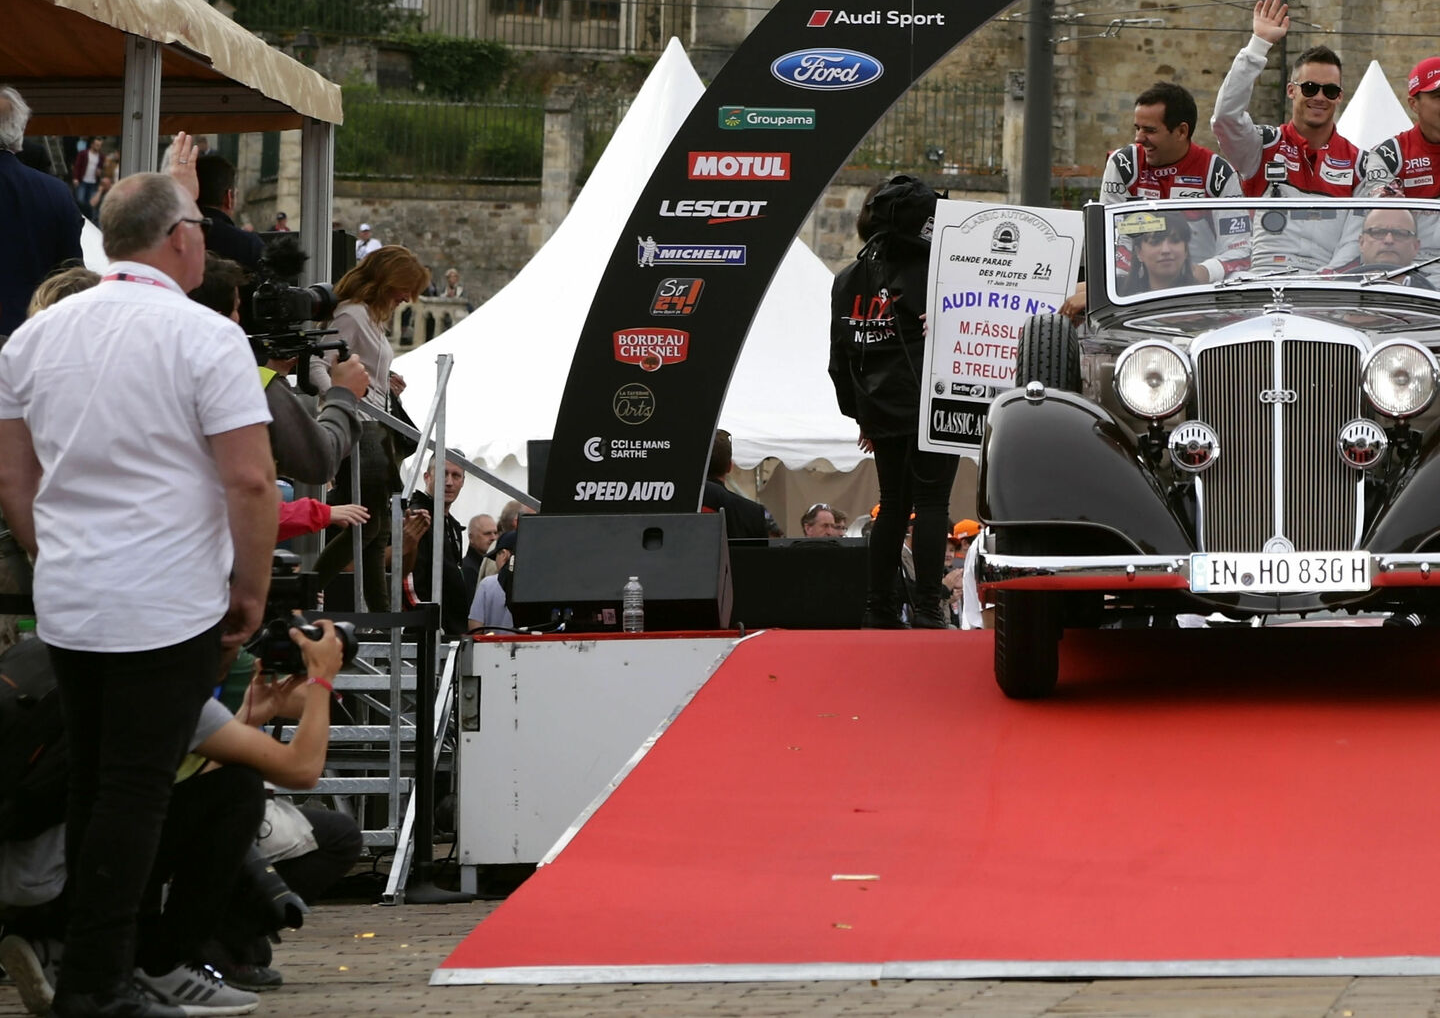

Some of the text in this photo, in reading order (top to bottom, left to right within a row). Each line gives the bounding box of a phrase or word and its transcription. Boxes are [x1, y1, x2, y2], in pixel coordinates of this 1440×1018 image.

[834, 10, 945, 28] Audi Sport
[793, 53, 861, 82] Ford
[746, 112, 813, 127] Groupama
[692, 155, 786, 177] MOTUL
[659, 200, 768, 218] LESCOT
[960, 211, 999, 235] CLASSIC
[1001, 210, 1057, 243] AUTOMOTIVE
[660, 249, 742, 260] MICHELIN
[950, 254, 1013, 267] GRANDE PARADE
[979, 268, 1028, 281] DES PILOTES
[1032, 262, 1053, 277] 24h
[660, 279, 689, 297] So
[942, 291, 982, 313] AUDI
[988, 292, 1021, 311] R18
[618, 335, 684, 346] BORDEAU
[854, 328, 896, 343] MEDIA
[620, 346, 681, 357] CHESNEL
[933, 409, 974, 435] CLASSIC
[611, 440, 670, 449] CCI LE MANS
[611, 450, 648, 458] SARTHE
[574, 481, 675, 501] SPEED AUTO
[1260, 559, 1290, 584] HO
[1352, 558, 1366, 583] H
